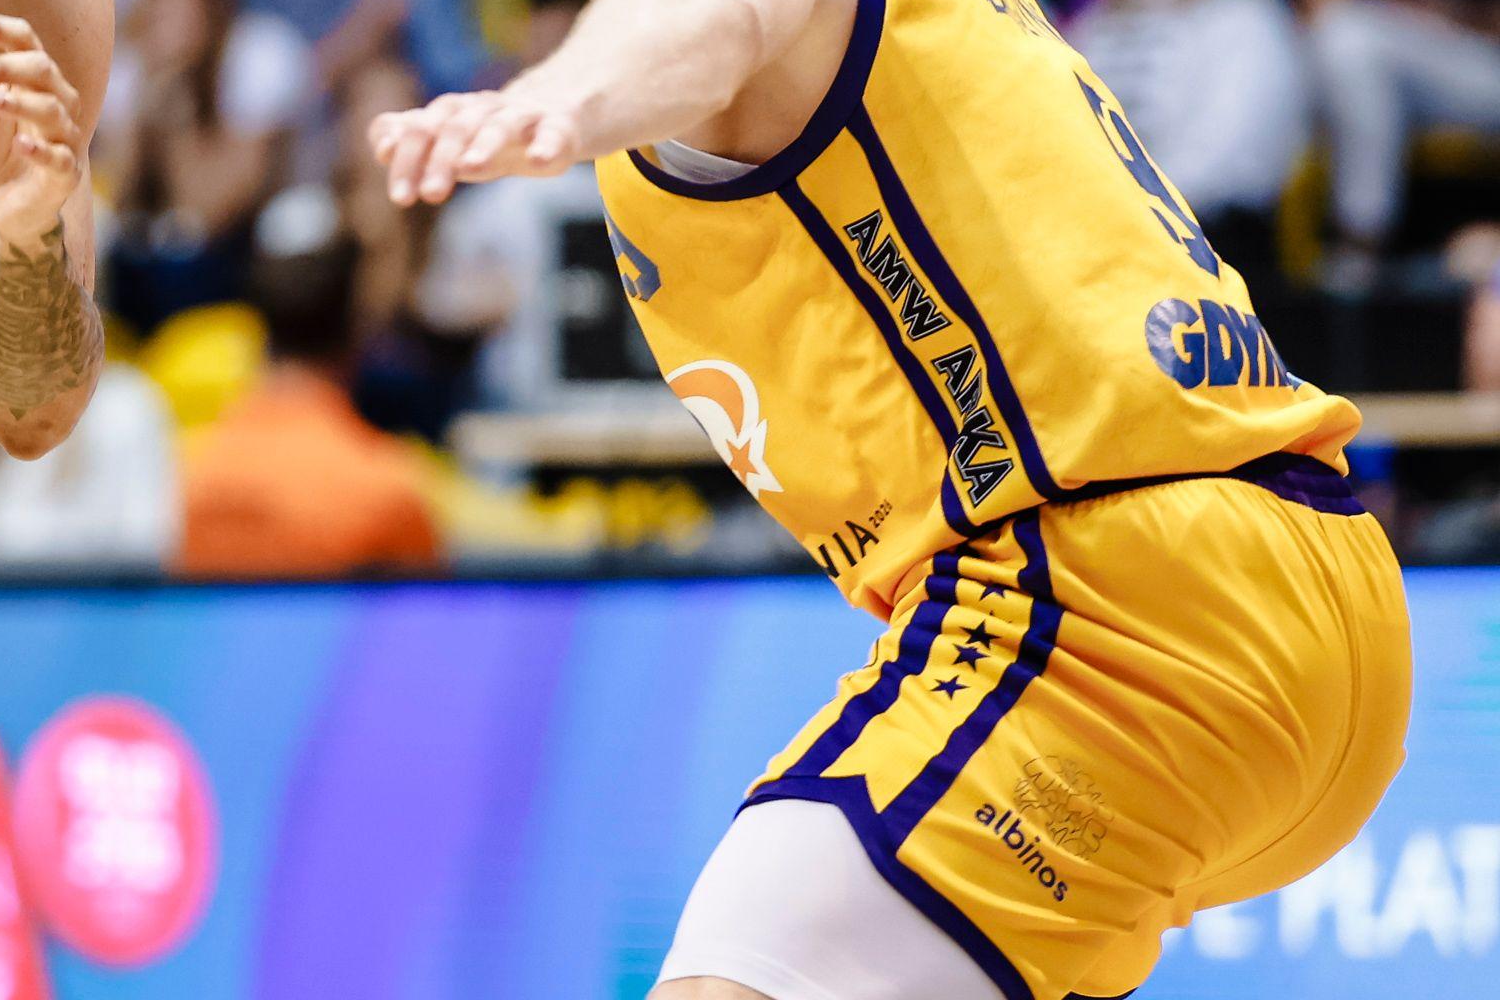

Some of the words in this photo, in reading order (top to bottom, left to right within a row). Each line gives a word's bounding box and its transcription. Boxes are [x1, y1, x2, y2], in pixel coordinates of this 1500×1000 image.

[844, 209, 953, 342] AMW
[1145, 298, 1292, 390] GDYN
[975, 803, 1068, 902] albinos
